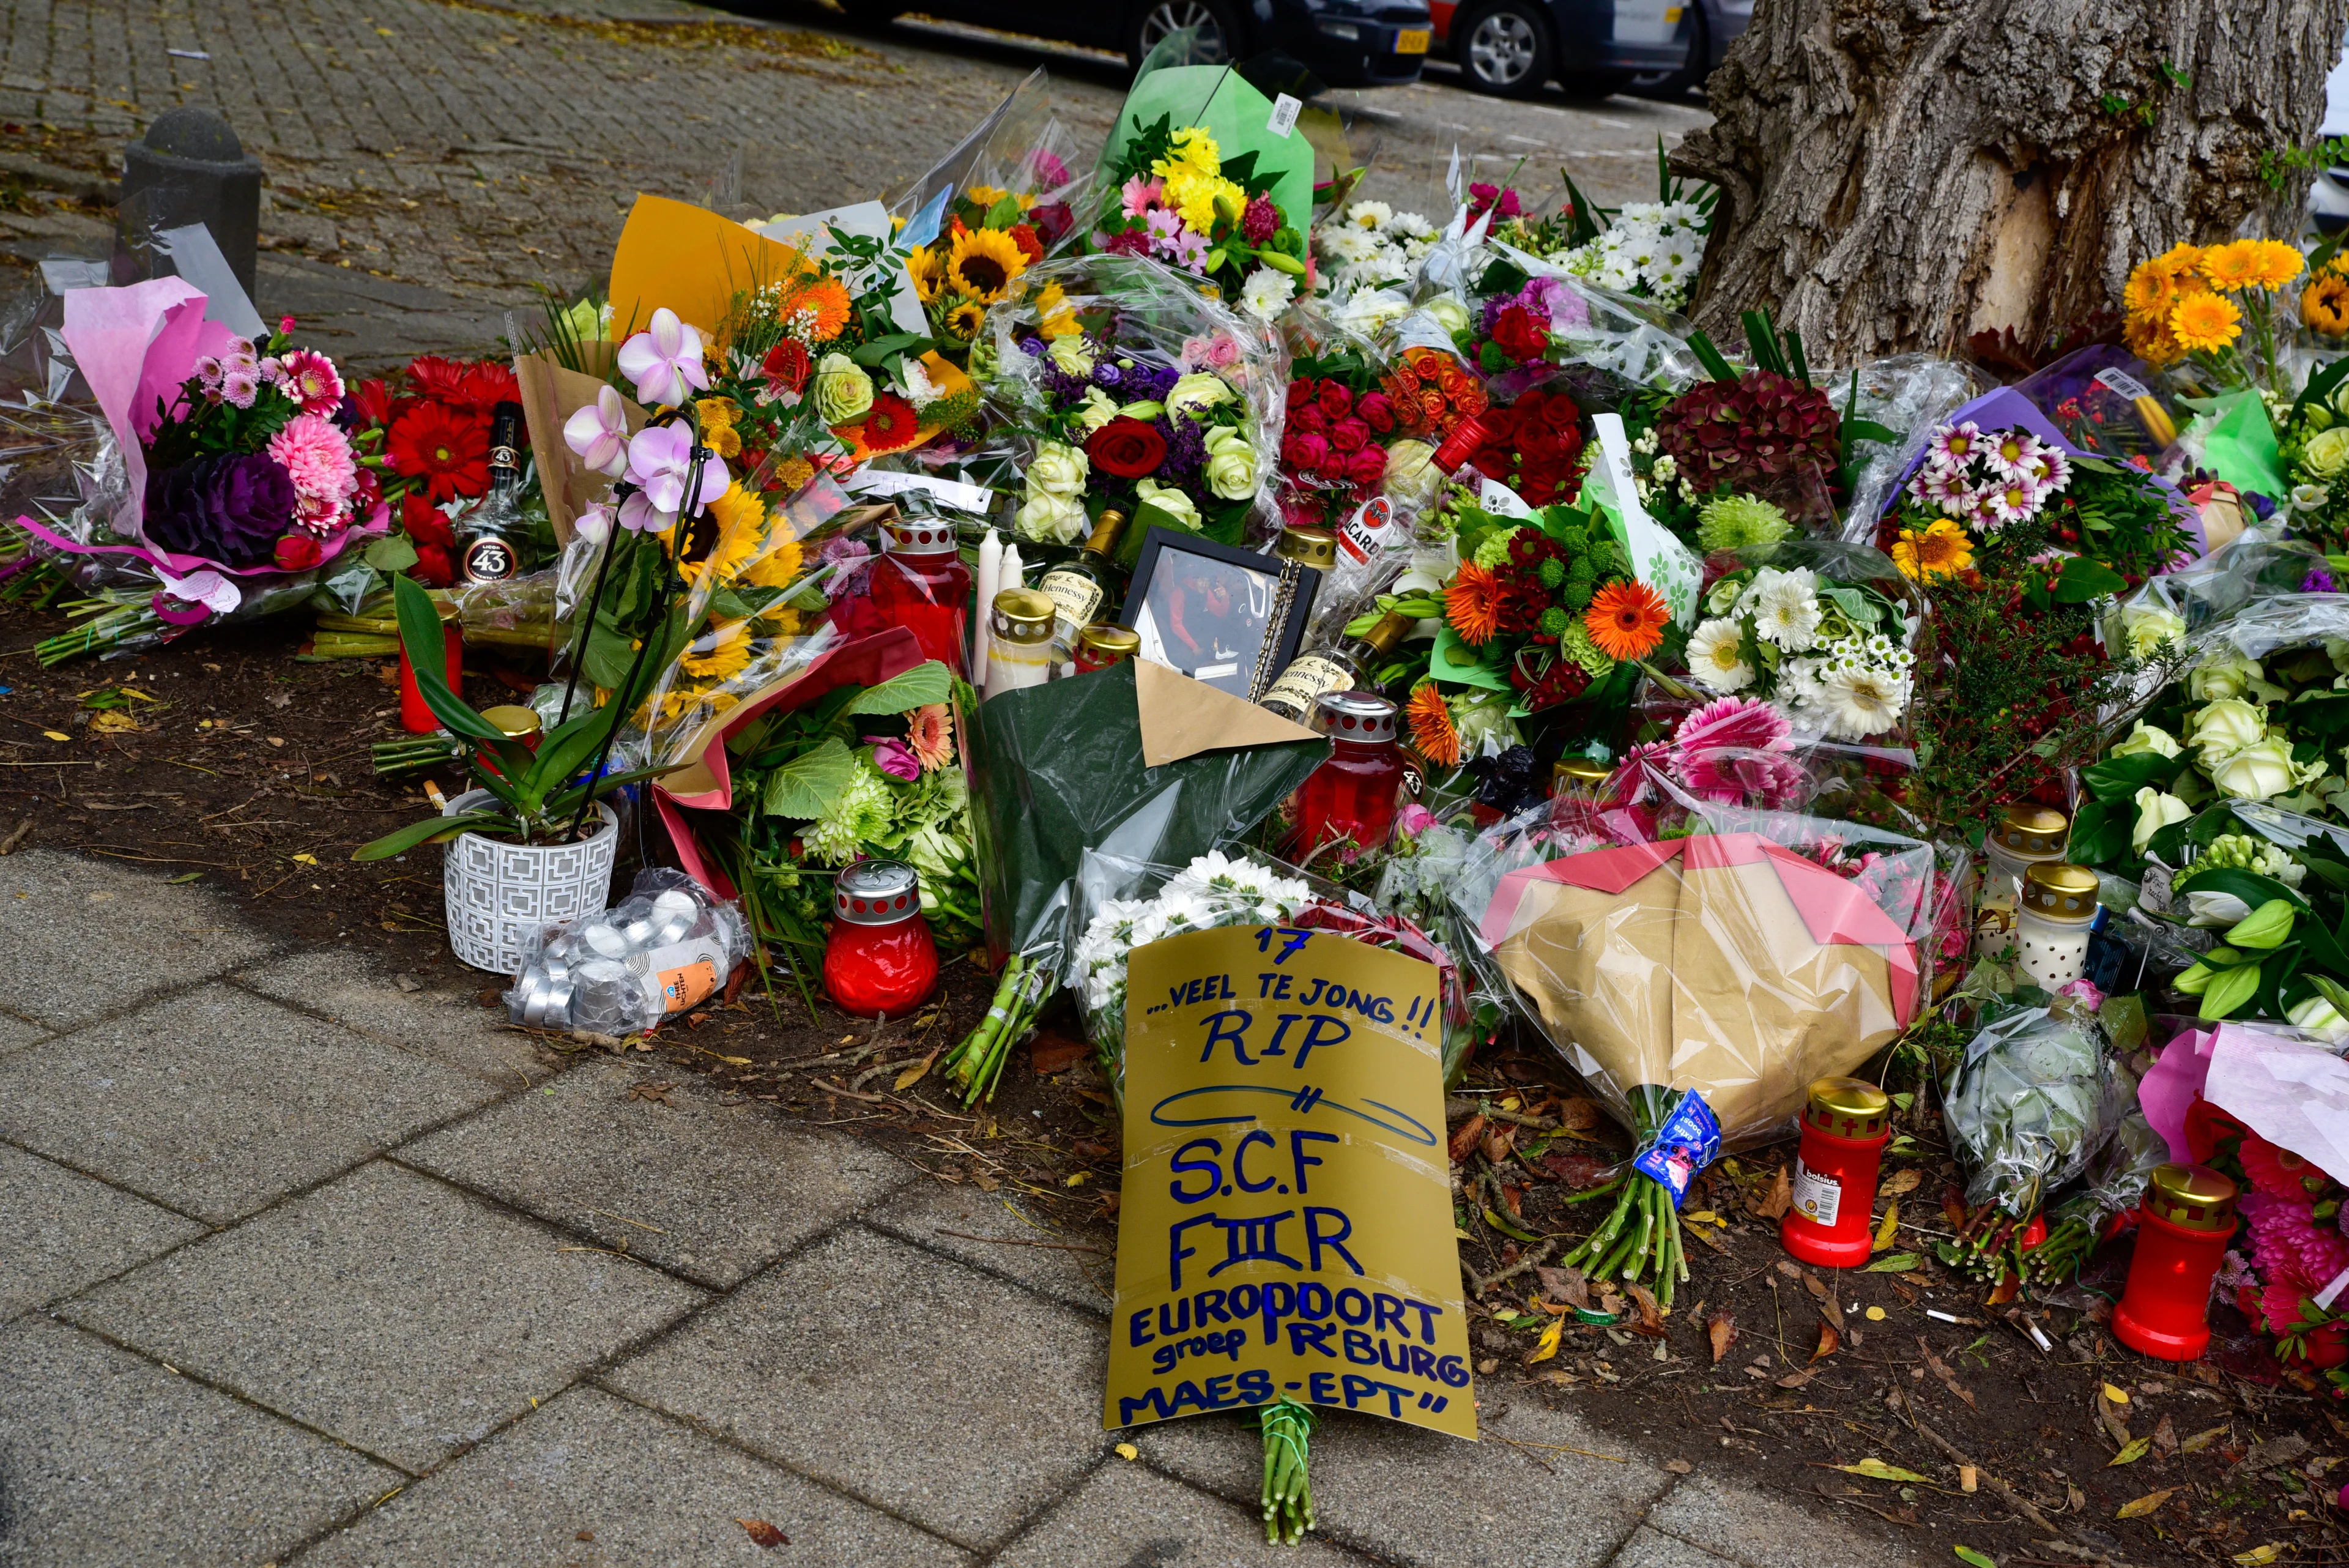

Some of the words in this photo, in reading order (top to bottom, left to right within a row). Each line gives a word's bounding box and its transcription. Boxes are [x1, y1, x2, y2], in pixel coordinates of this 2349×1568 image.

[495, 451, 510, 462] 43
[472, 549, 506, 573] 43
[469, 567, 493, 580] CUARENTA
[1043, 584, 1087, 603] Hennessy
[1403, 771, 1422, 795] 43
[2153, 875, 2165, 889] Rust
[2148, 888, 2162, 902] zacht
[1255, 927, 1315, 965] 17
[1258, 973, 1293, 1000] TE
[1299, 979, 1393, 1024] JONG
[1199, 1009, 1351, 1069] RIP
[1674, 1124, 1693, 1141] extra
[1680, 1116, 1702, 1136] boost
[1693, 1141, 1702, 1151] de
[1646, 1160, 1658, 1170] DAG
[1649, 1150, 1663, 1164] 5
[1170, 1130, 1339, 1204] S.C.F
[1152, 1329, 1246, 1375] groep
